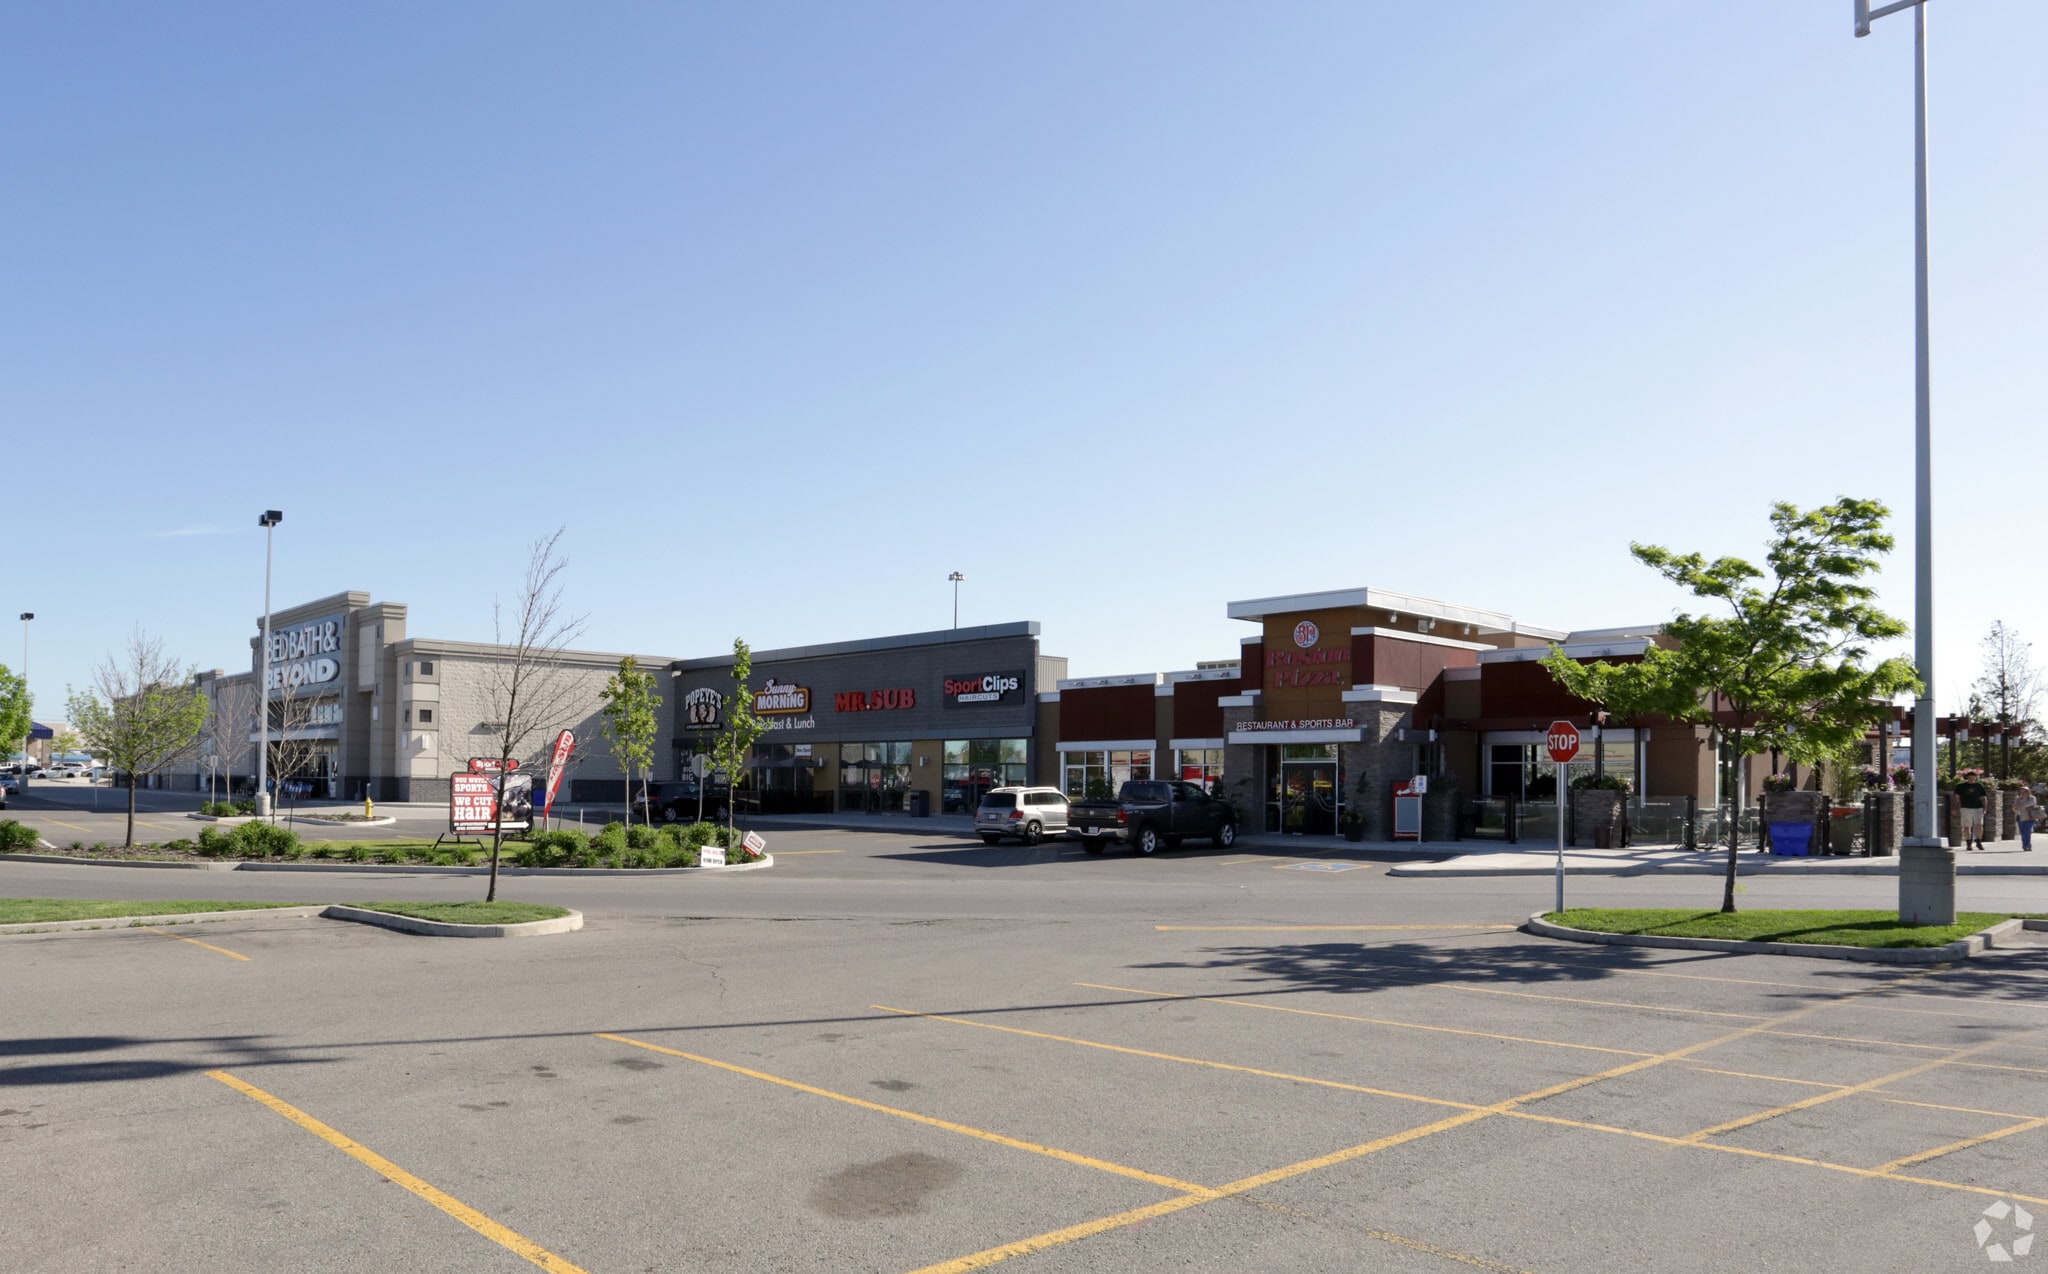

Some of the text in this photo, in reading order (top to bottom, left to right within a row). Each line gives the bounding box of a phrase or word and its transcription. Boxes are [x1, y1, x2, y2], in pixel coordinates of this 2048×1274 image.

[268, 621, 336, 662] BED BATH &
[1264, 648, 1350, 668] Boston
[267, 658, 337, 690] BEYOND
[1273, 670, 1340, 688] Pizza
[764, 679, 797, 696] Sunny
[944, 676, 1018, 696] SportClips
[685, 687, 723, 710] POPEYE'S
[834, 688, 916, 712] MR.SUB
[959, 693, 998, 701] HAIRCUTS
[785, 717, 792, 729] &
[794, 715, 815, 728] Lunch
[1236, 718, 1353, 731] RESTAURANT & SPORTS BAR
[1548, 734, 1577, 750] STOP
[454, 784, 488, 792] SPORTS
